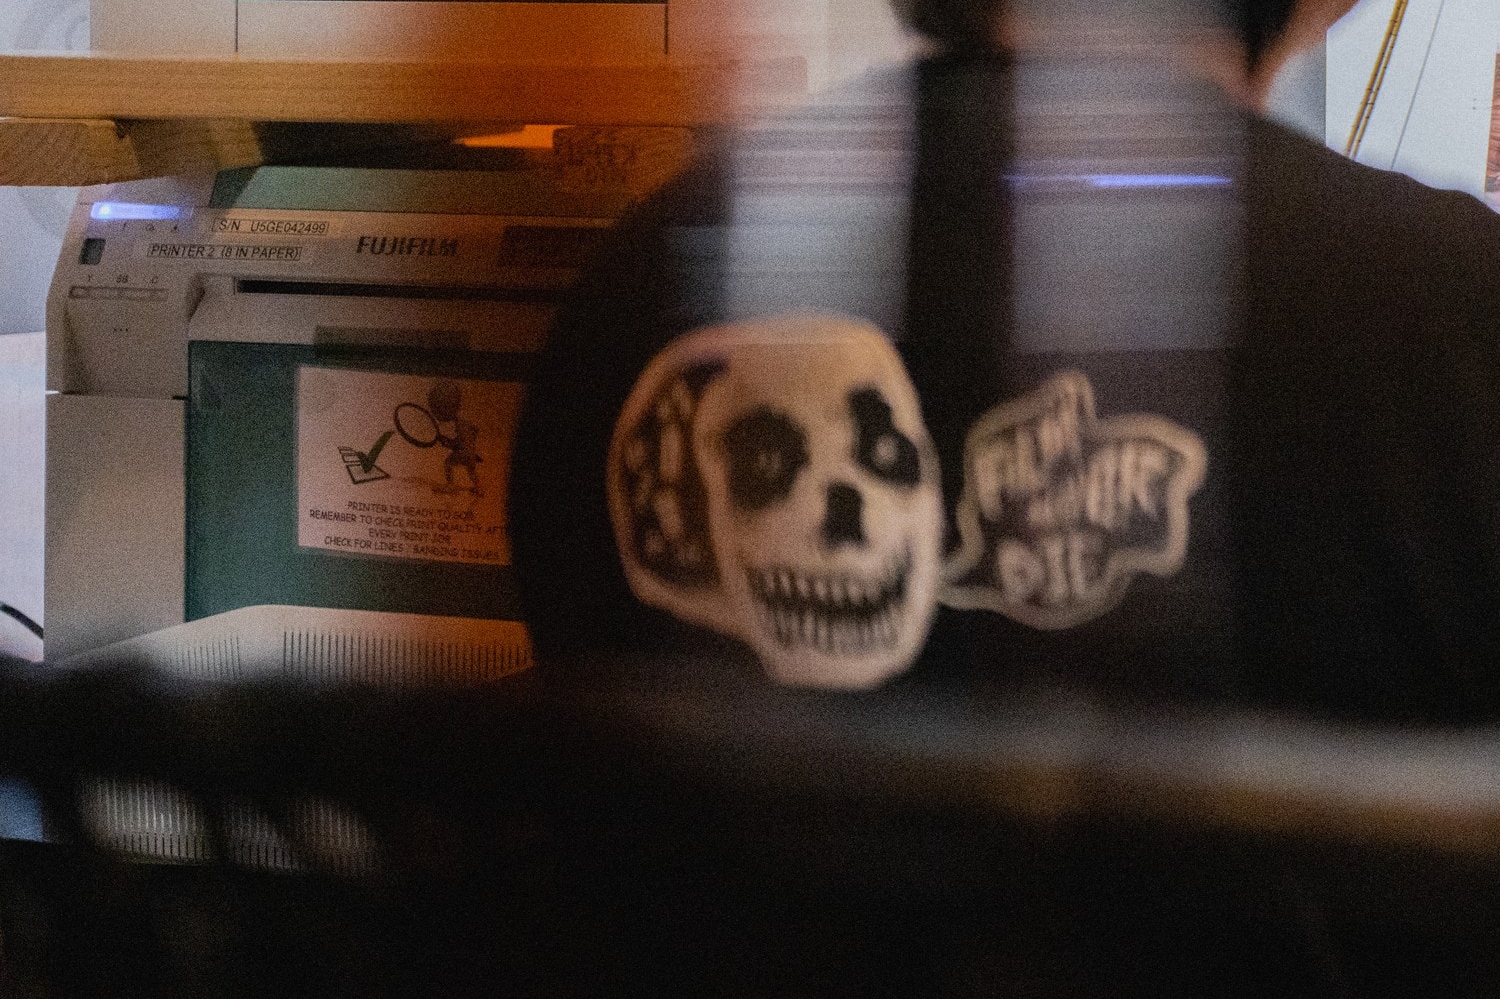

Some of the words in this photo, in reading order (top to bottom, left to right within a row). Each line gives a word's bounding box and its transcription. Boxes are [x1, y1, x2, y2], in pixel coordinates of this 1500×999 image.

[217, 218, 242, 233] S/N
[150, 243, 206, 258] PRINTER
[220, 245, 232, 260] (8
[234, 246, 249, 259] IN
[251, 246, 301, 261] PAPER)
[355, 235, 460, 258] FUJIFILM
[309, 508, 357, 524] REMEMBER
[360, 514, 372, 525] TO
[324, 535, 352, 548] CHECK
[354, 537, 372, 550] FOR
